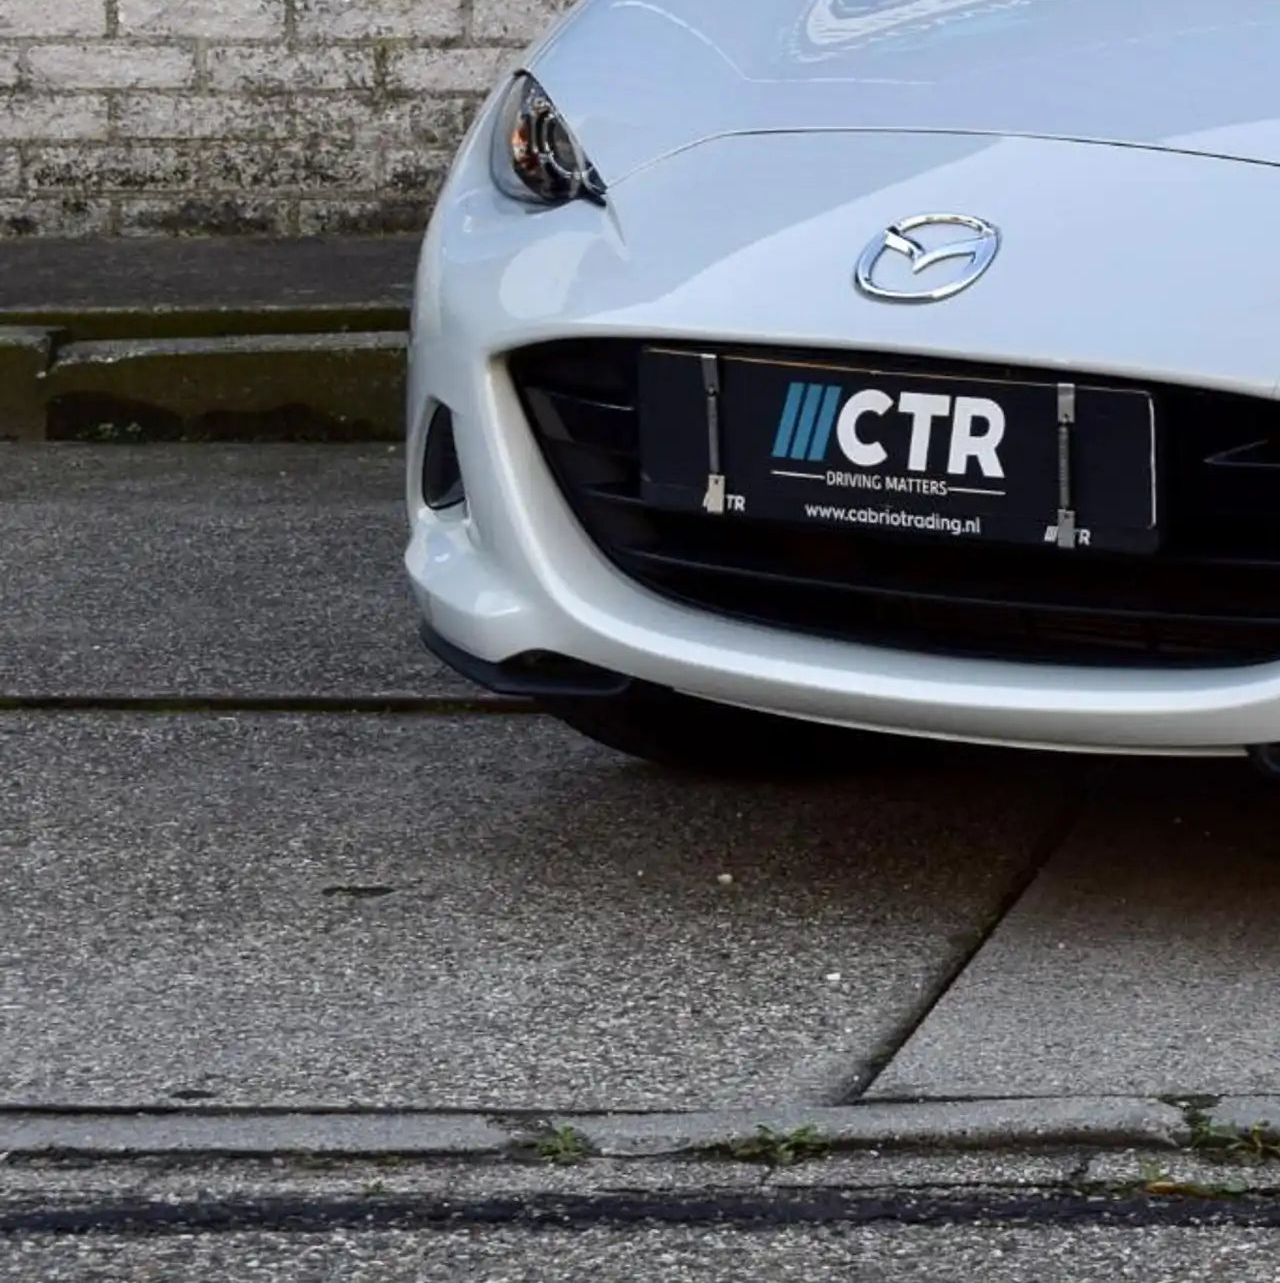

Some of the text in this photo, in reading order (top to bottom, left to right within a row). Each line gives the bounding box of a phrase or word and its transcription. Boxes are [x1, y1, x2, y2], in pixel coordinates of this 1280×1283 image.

[837, 389, 1006, 478] CTR
[826, 471, 948, 495] DRIVING MATTERS
[805, 504, 980, 534] www.cabriotrading.nl
